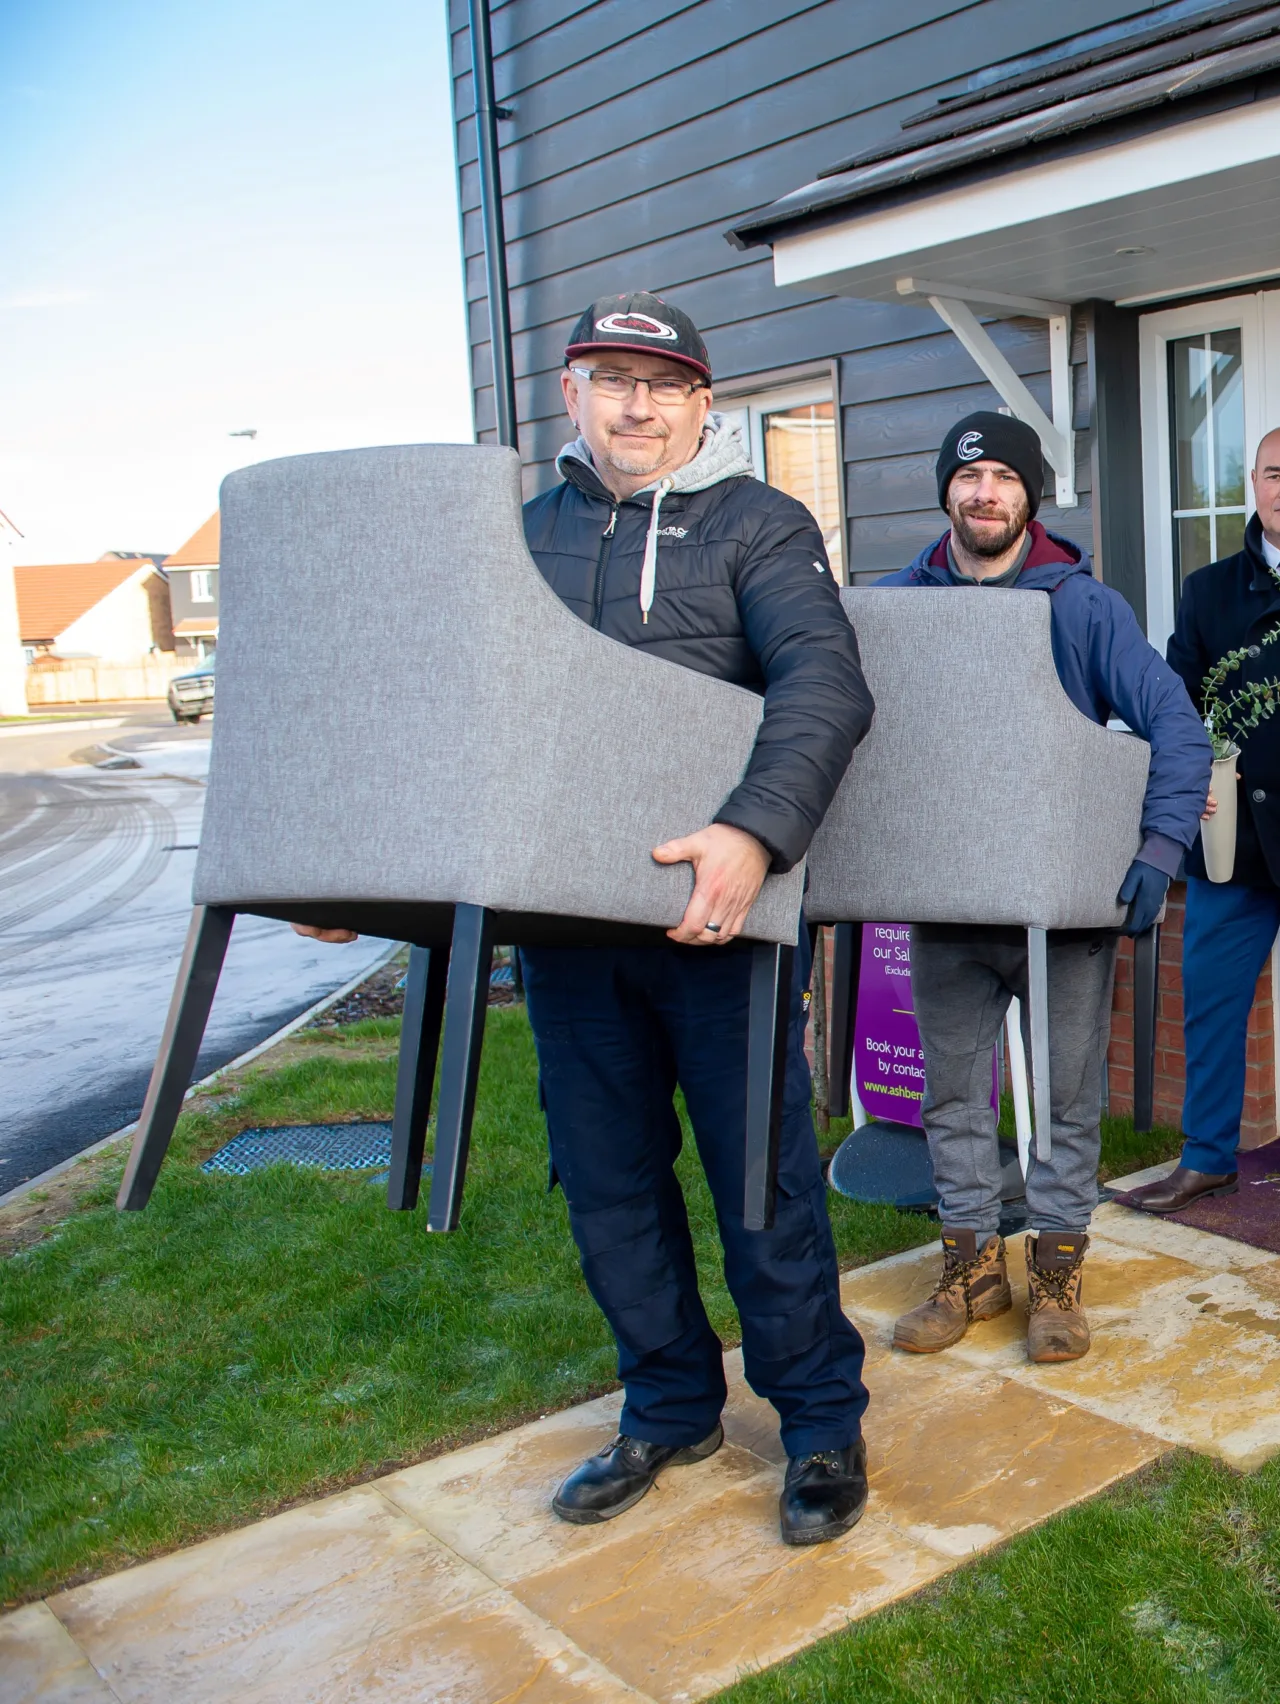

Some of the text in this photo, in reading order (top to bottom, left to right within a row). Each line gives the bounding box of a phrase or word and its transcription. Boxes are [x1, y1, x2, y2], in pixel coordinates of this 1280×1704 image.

[873, 947, 891, 959] our
[866, 1037, 891, 1054] Book
[893, 1045, 916, 1058] your
[878, 1057, 891, 1075] by
